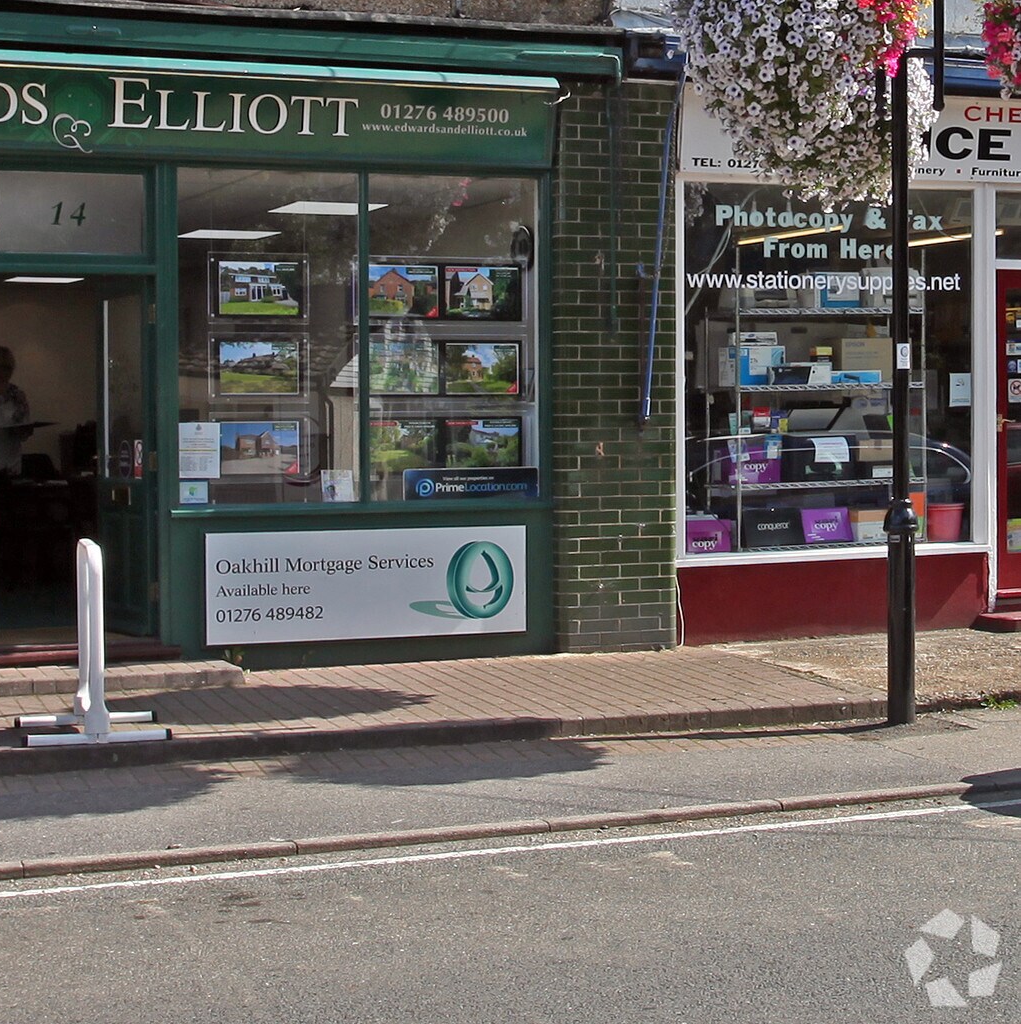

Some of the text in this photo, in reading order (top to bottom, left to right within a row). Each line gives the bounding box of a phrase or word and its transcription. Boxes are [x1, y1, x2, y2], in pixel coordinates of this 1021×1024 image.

[107, 76, 359, 137] ELLIOTT
[380, 103, 510, 124] 01276 489500
[964, 105, 1021, 123] CHE
[361, 122, 528, 137] www.edwardsandelliott.co.uk
[692, 157, 759, 169] TEL: 0127
[915, 167, 1021, 177] nery Furnitur
[51, 201, 86, 226] 14
[715, 204, 943, 233] Photocopy & ax
[763, 238, 828, 258] From
[686, 271, 961, 294] www.stationerysuppes.net
[743, 463, 768, 473] copy
[435, 482, 528, 493] PrimeLocation.com
[757, 521, 790, 531] conqueror
[814, 523, 838, 533] copy
[691, 540, 718, 551] copy
[216, 553, 434, 575] Oakhill Mortgage Services
[215, 582, 311, 598] Available here
[215, 605, 324, 623] 01276 489482
